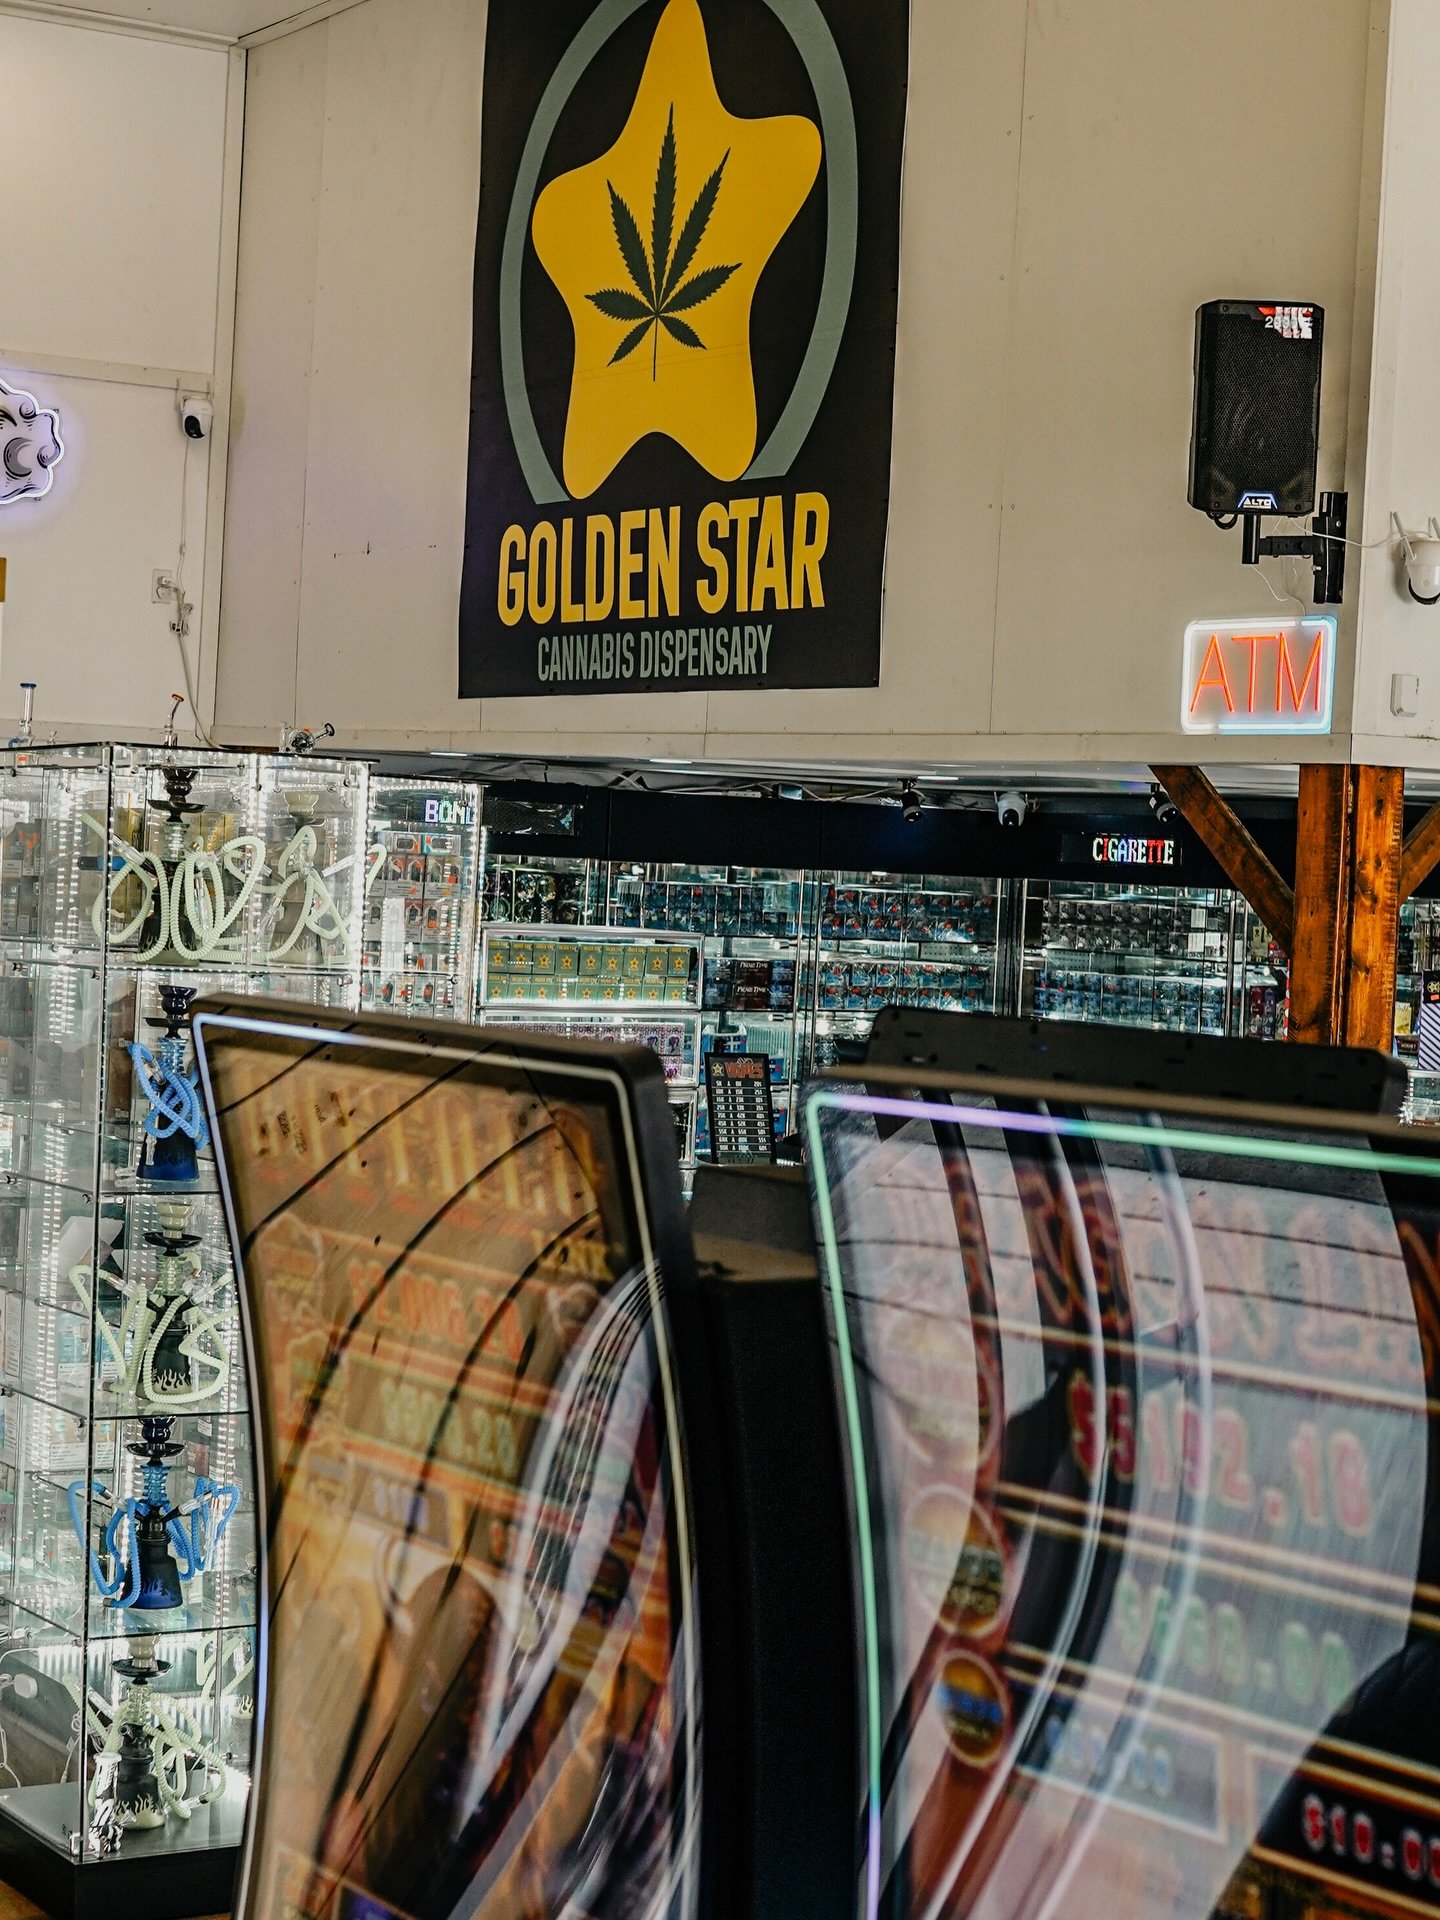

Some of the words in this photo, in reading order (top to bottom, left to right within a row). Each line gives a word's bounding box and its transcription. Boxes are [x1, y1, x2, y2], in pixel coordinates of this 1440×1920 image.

[1243, 497, 1272, 506] ALTO
[497, 505, 680, 626] GOLDEN
[696, 491, 830, 614] STAR
[538, 631, 635, 681] CANNABIS
[640, 624, 773, 678] DISPENSARY
[1189, 630, 1325, 714] ATM
[1092, 837, 1175, 865] CIGARETTE
[724, 1062, 764, 1078] VAPES
